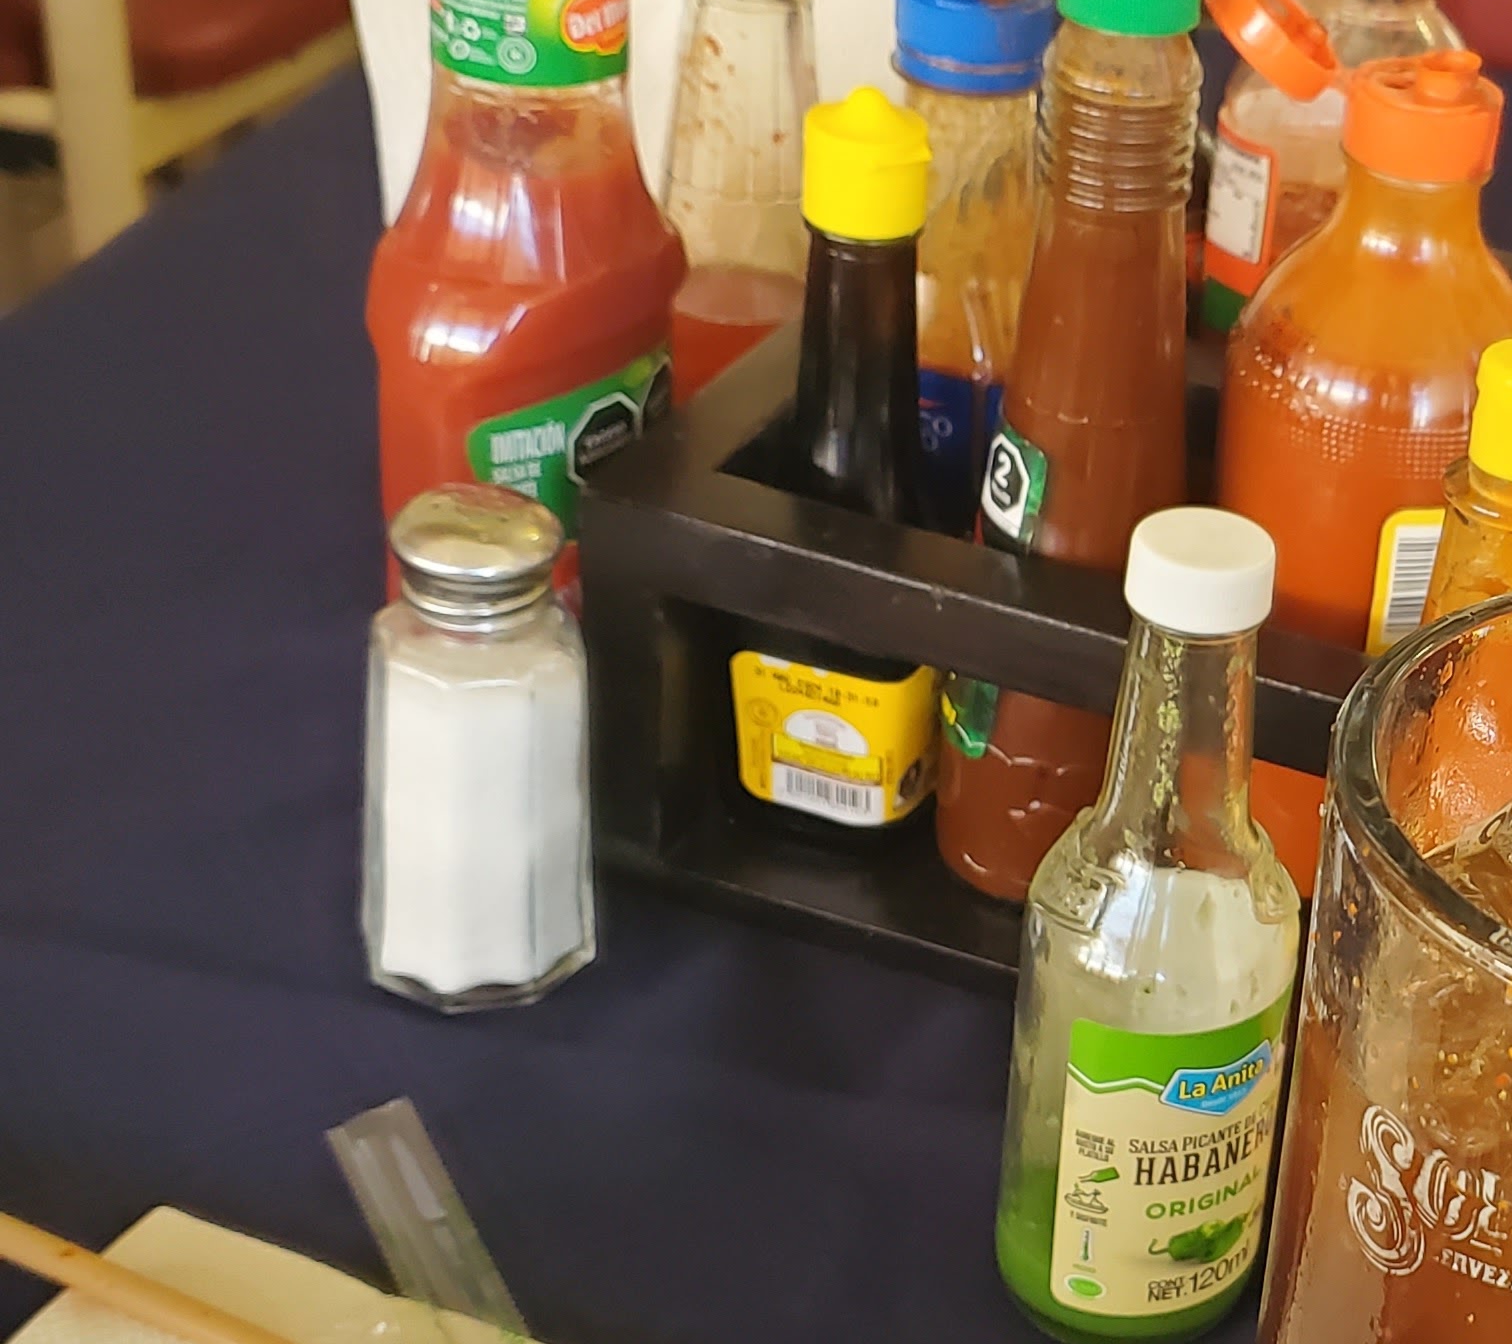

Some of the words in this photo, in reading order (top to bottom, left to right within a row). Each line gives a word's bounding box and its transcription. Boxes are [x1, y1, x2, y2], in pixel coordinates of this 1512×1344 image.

[993, 450, 1012, 489] 2
[1178, 1080, 1207, 1100] La
[1210, 1058, 1265, 1094] Anita
[1128, 1138, 1178, 1154] SALSA
[1182, 1120, 1242, 1152] PICANTE
[1145, 1166, 1262, 1219] ORIGINAL
